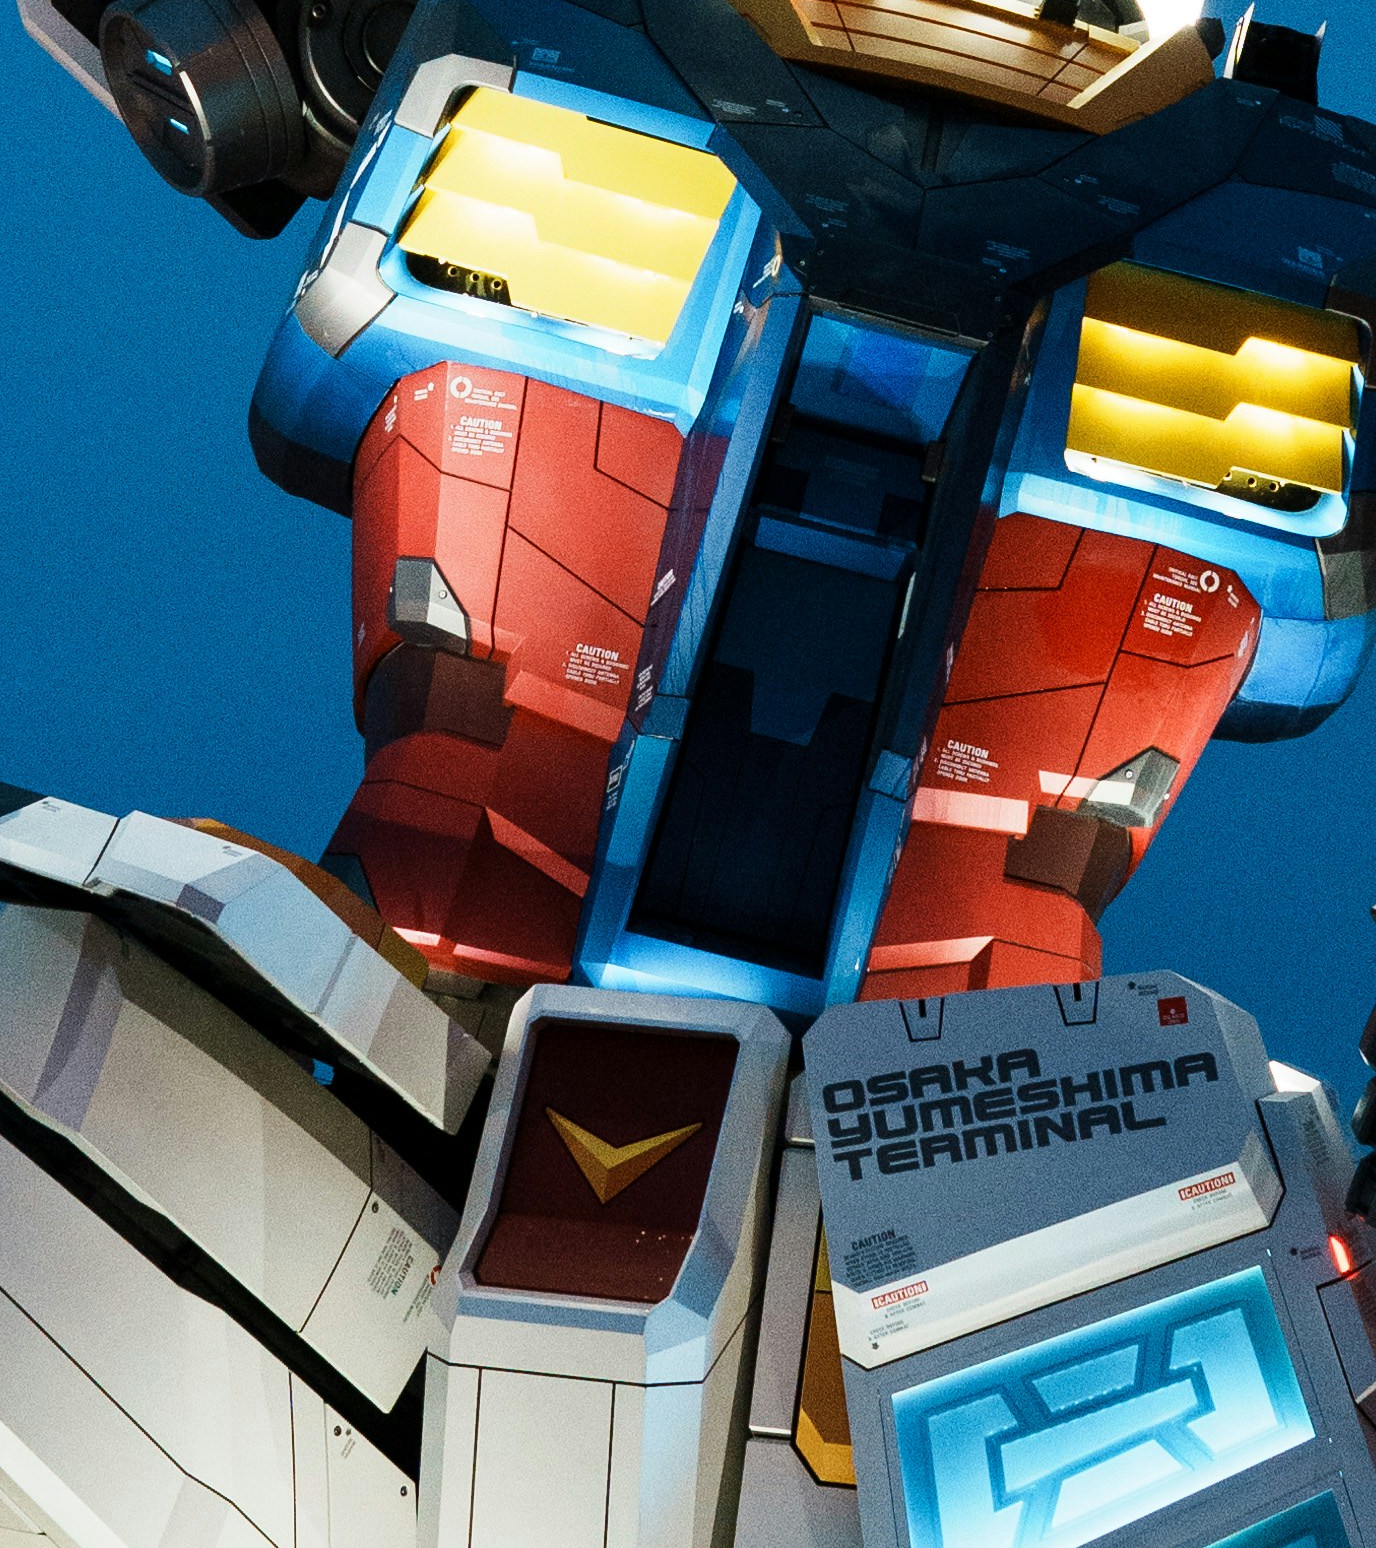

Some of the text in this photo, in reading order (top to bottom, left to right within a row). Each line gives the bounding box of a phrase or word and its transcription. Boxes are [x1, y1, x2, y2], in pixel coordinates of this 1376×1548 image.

[459, 415, 503, 431] CAUTION
[1153, 593, 1194, 614] CAUTION
[575, 643, 620, 662] CAUTION
[947, 739, 990, 759] CAUTION
[823, 1047, 1042, 1115] OSAKA
[826, 1051, 1220, 1150] YUMESHIMA
[832, 1100, 1169, 1182] TERMINAL
[850, 1228, 897, 1252] CAUTION
